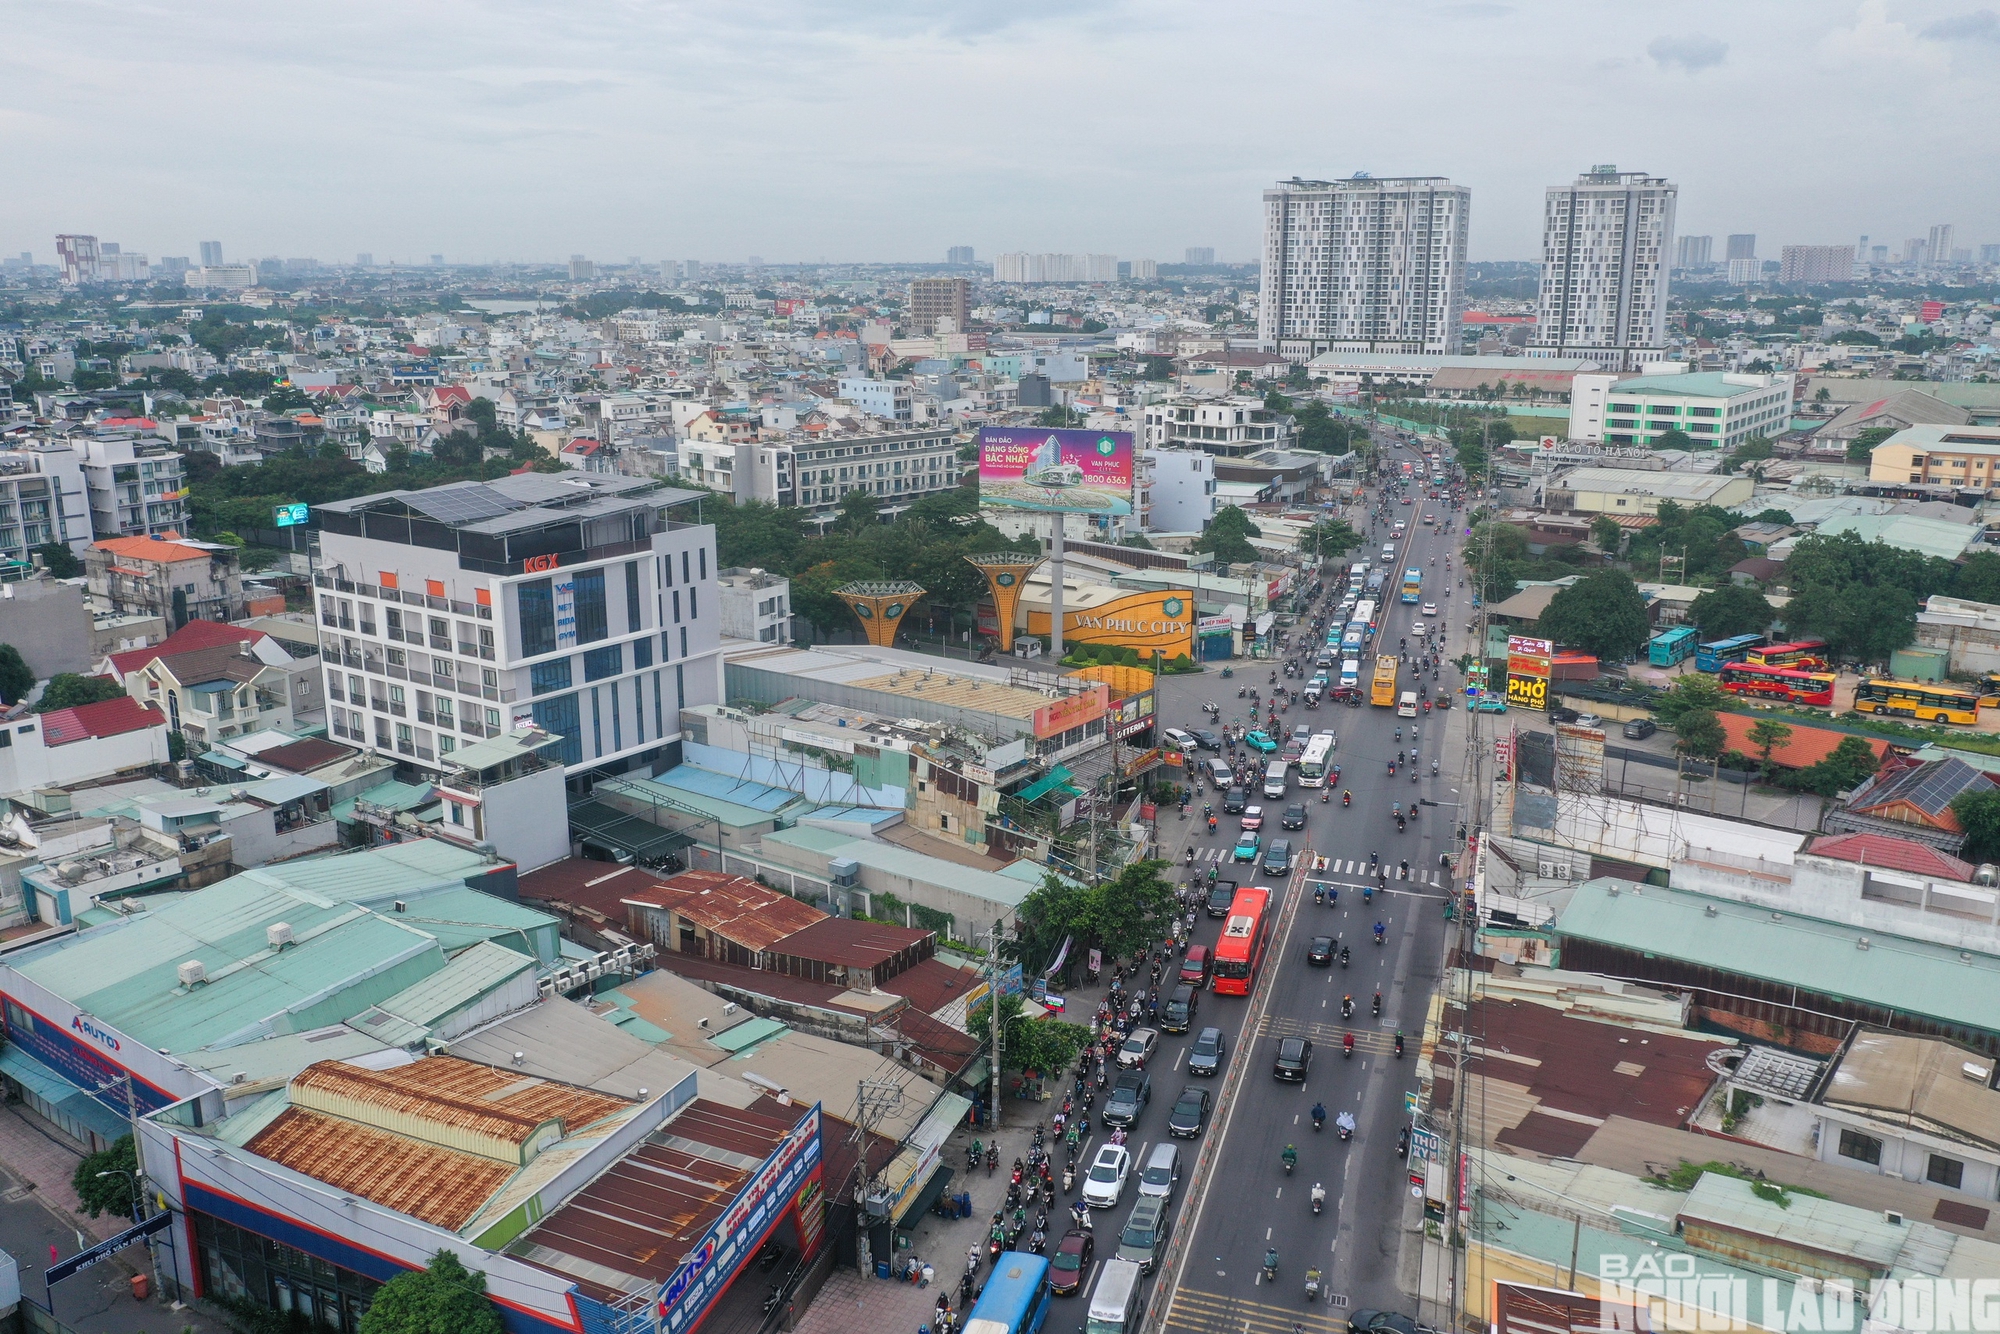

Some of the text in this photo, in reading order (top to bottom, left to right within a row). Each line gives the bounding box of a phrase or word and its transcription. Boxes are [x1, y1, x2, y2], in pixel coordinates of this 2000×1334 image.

[985, 444, 1029, 454] ĐÁNG SỐNG
[1586, 443, 1600, 455] TÔ
[1605, 444, 1621, 456] HÀ
[985, 453, 1029, 464] BẬC NHẤT
[1084, 475, 1127, 484] 1800 6363
[523, 553, 560, 574] KGX
[1075, 614, 1189, 634] VAN PHUC CITY
[1509, 678, 1546, 698] PHỞ
[1508, 694, 1528, 703] HÀNG
[1530, 696, 1545, 705] PHỐ
[1116, 721, 1145, 739] OTTERIA
[1413, 1133, 1437, 1150] THÚ
[76, 1259, 93, 1272] KHU
[95, 1250, 112, 1262] PHỐ
